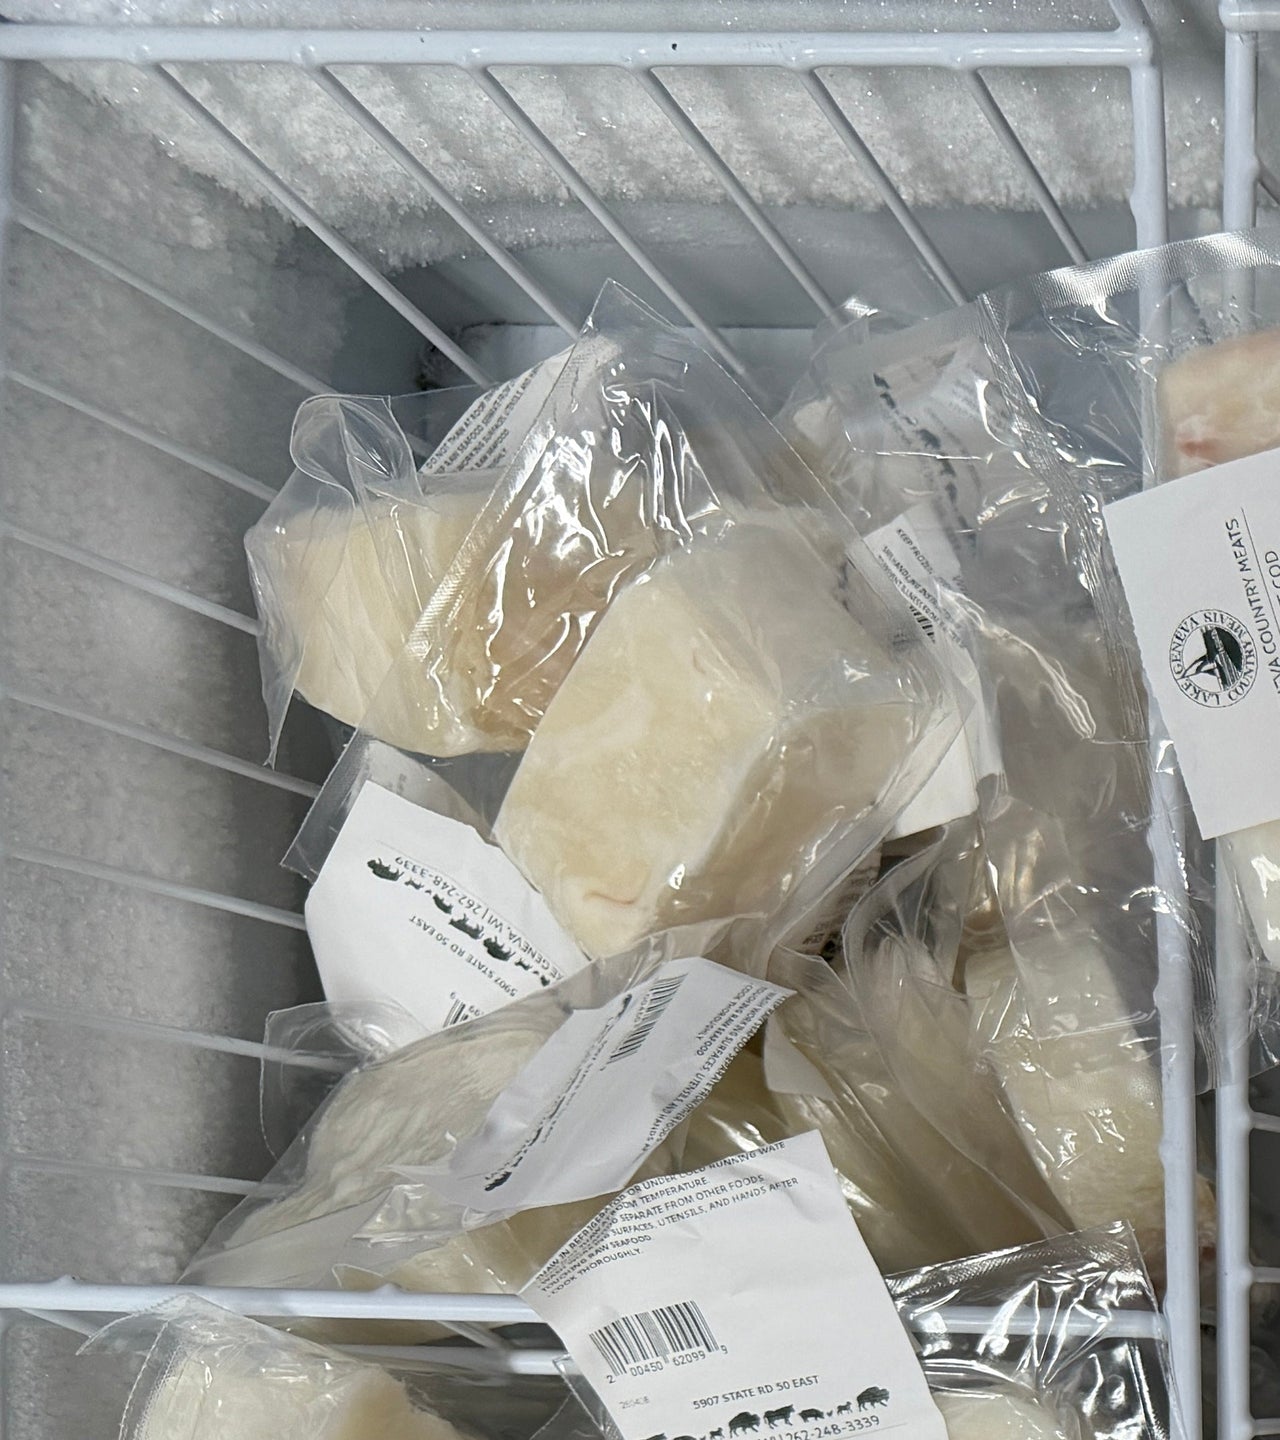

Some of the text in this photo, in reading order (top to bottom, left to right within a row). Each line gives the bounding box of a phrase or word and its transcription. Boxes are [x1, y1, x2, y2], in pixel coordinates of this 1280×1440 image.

[1223, 517, 1252, 573] MEATS
[1240, 576, 1277, 655] COUNTRY
[393, 855, 483, 916] 262-248-3339
[691, 1373, 819, 1410] 5907 STATE RD 50 EAST
